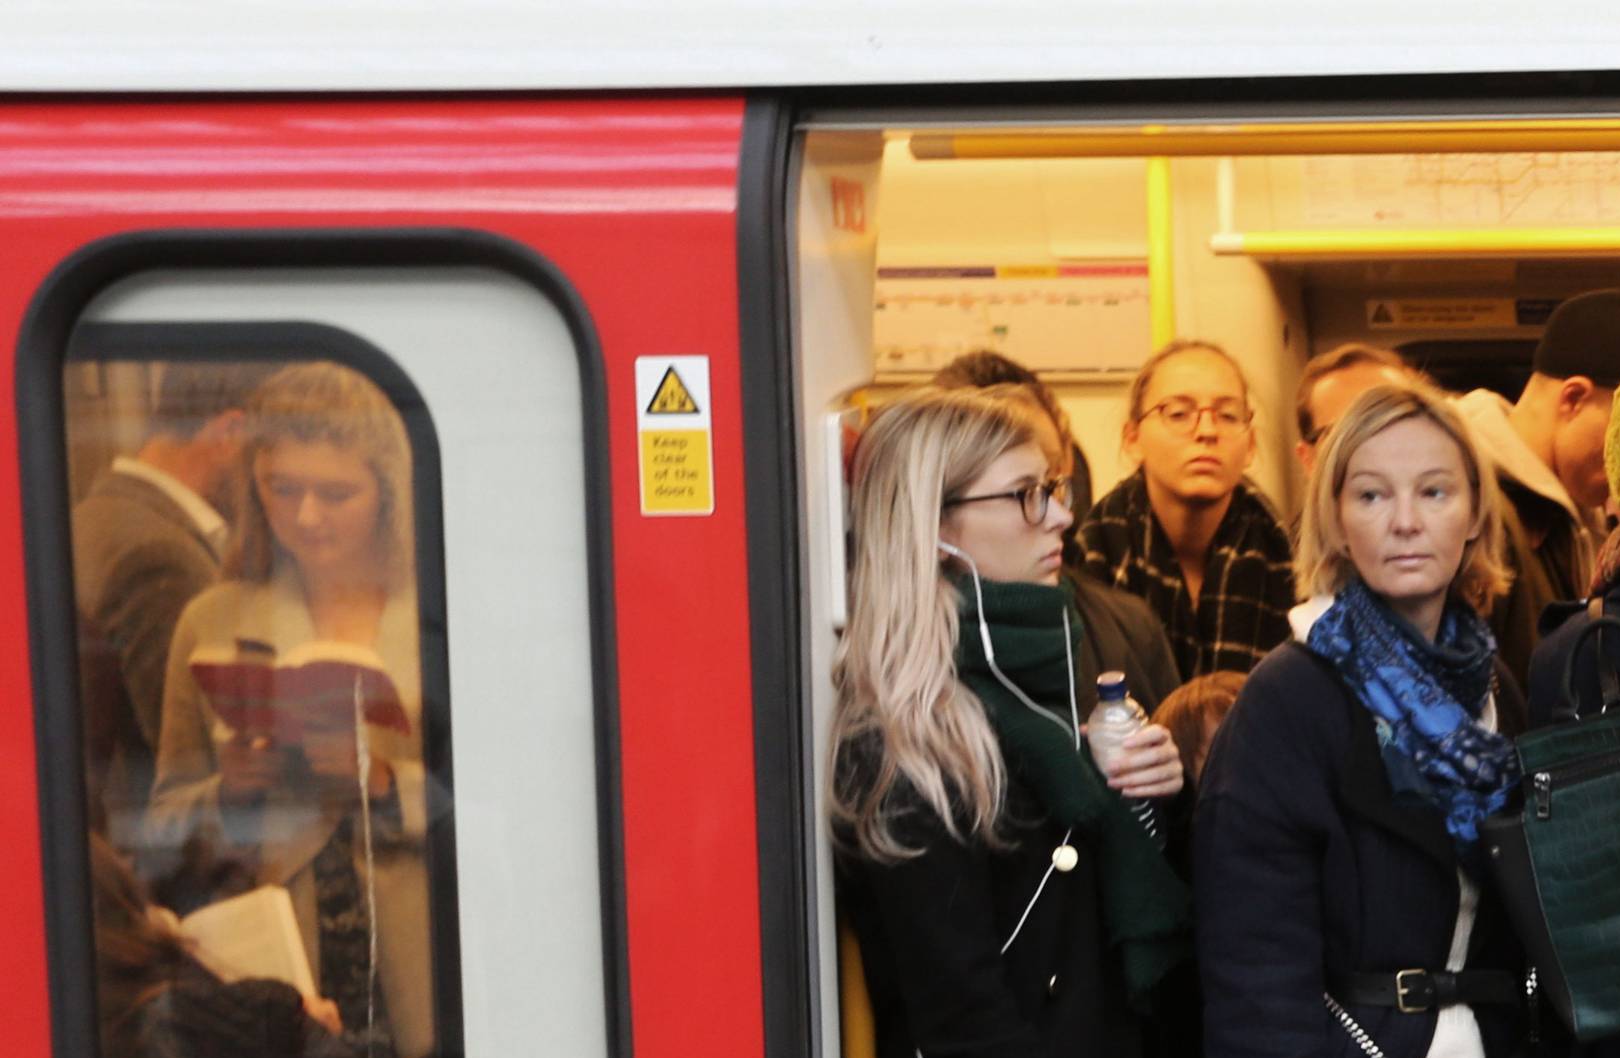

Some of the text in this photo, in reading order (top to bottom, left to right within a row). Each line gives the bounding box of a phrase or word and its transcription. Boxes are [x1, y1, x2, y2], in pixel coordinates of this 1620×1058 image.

[652, 436, 688, 450] Keep
[652, 453, 687, 464] clear
[653, 468, 699, 479] of the
[655, 483, 695, 496] doors
